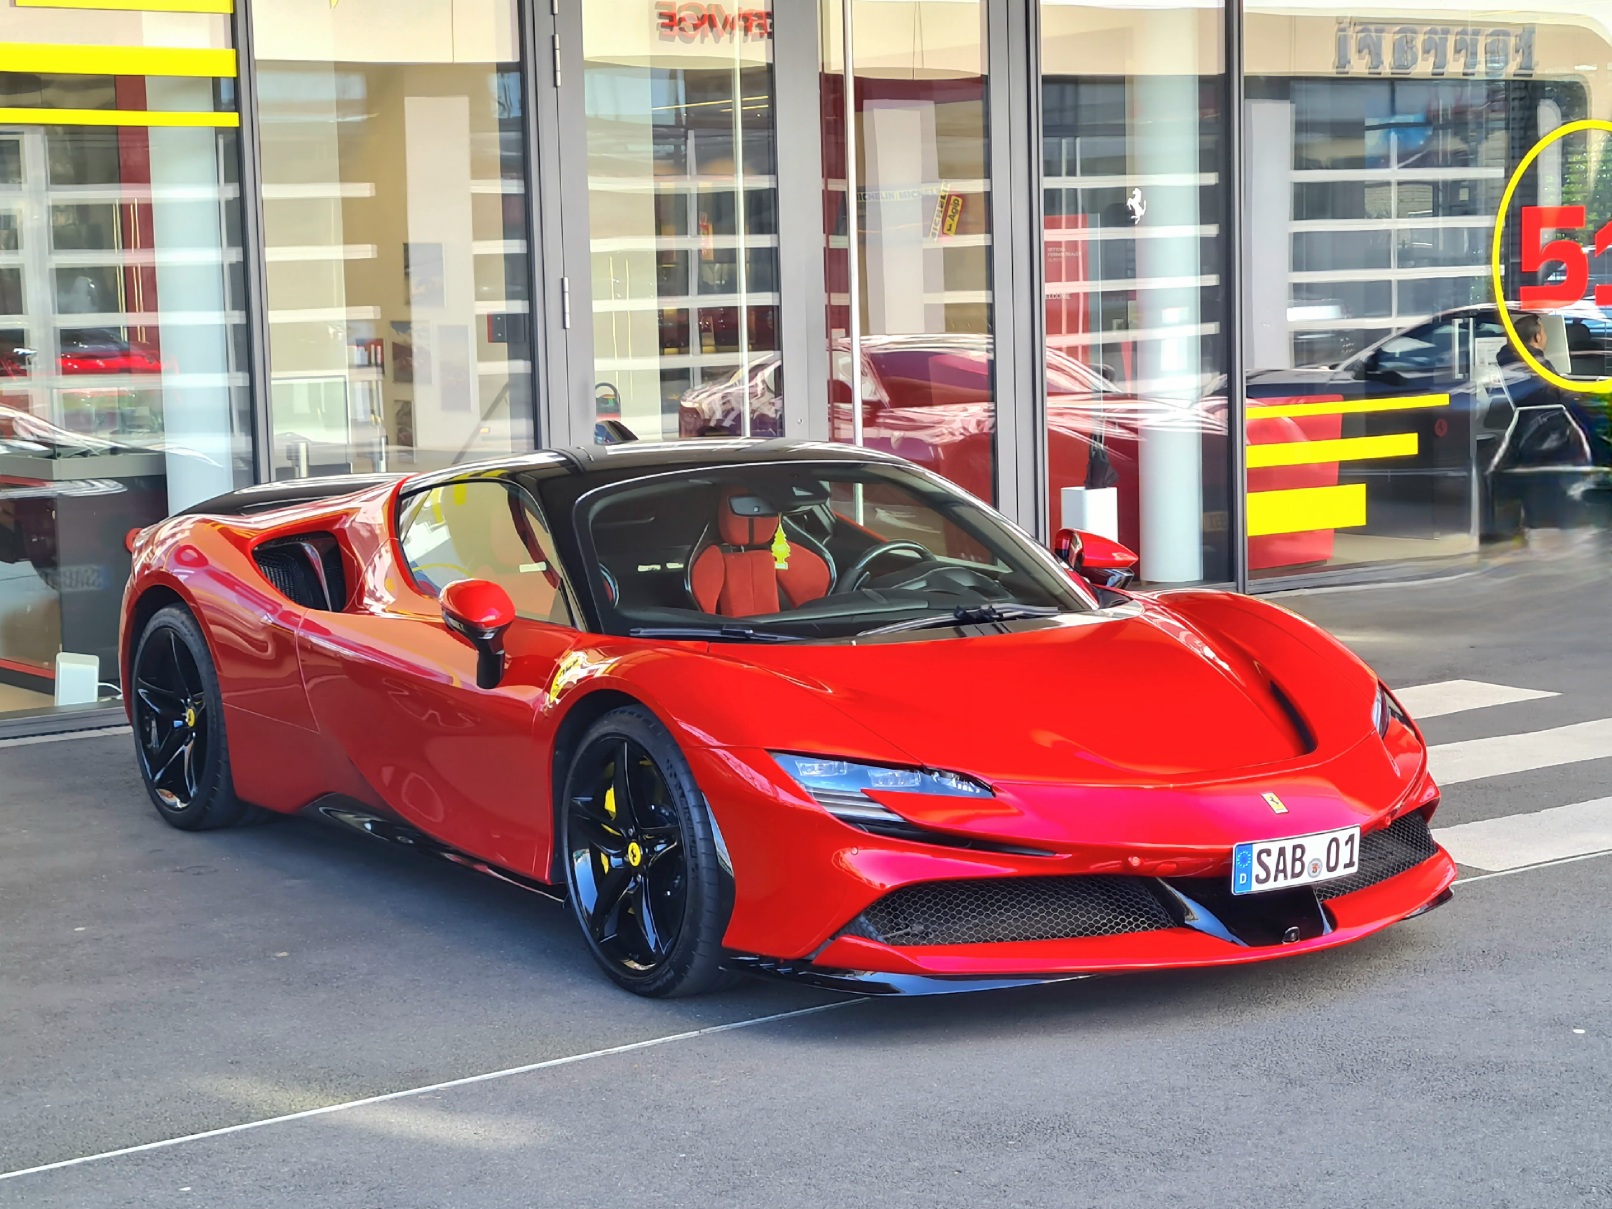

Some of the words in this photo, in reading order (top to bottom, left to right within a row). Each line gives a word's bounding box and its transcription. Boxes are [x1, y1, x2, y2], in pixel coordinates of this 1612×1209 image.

[1255, 843, 1306, 885] SAB
[1326, 833, 1356, 873] 01
[1240, 873, 1247, 884] D
